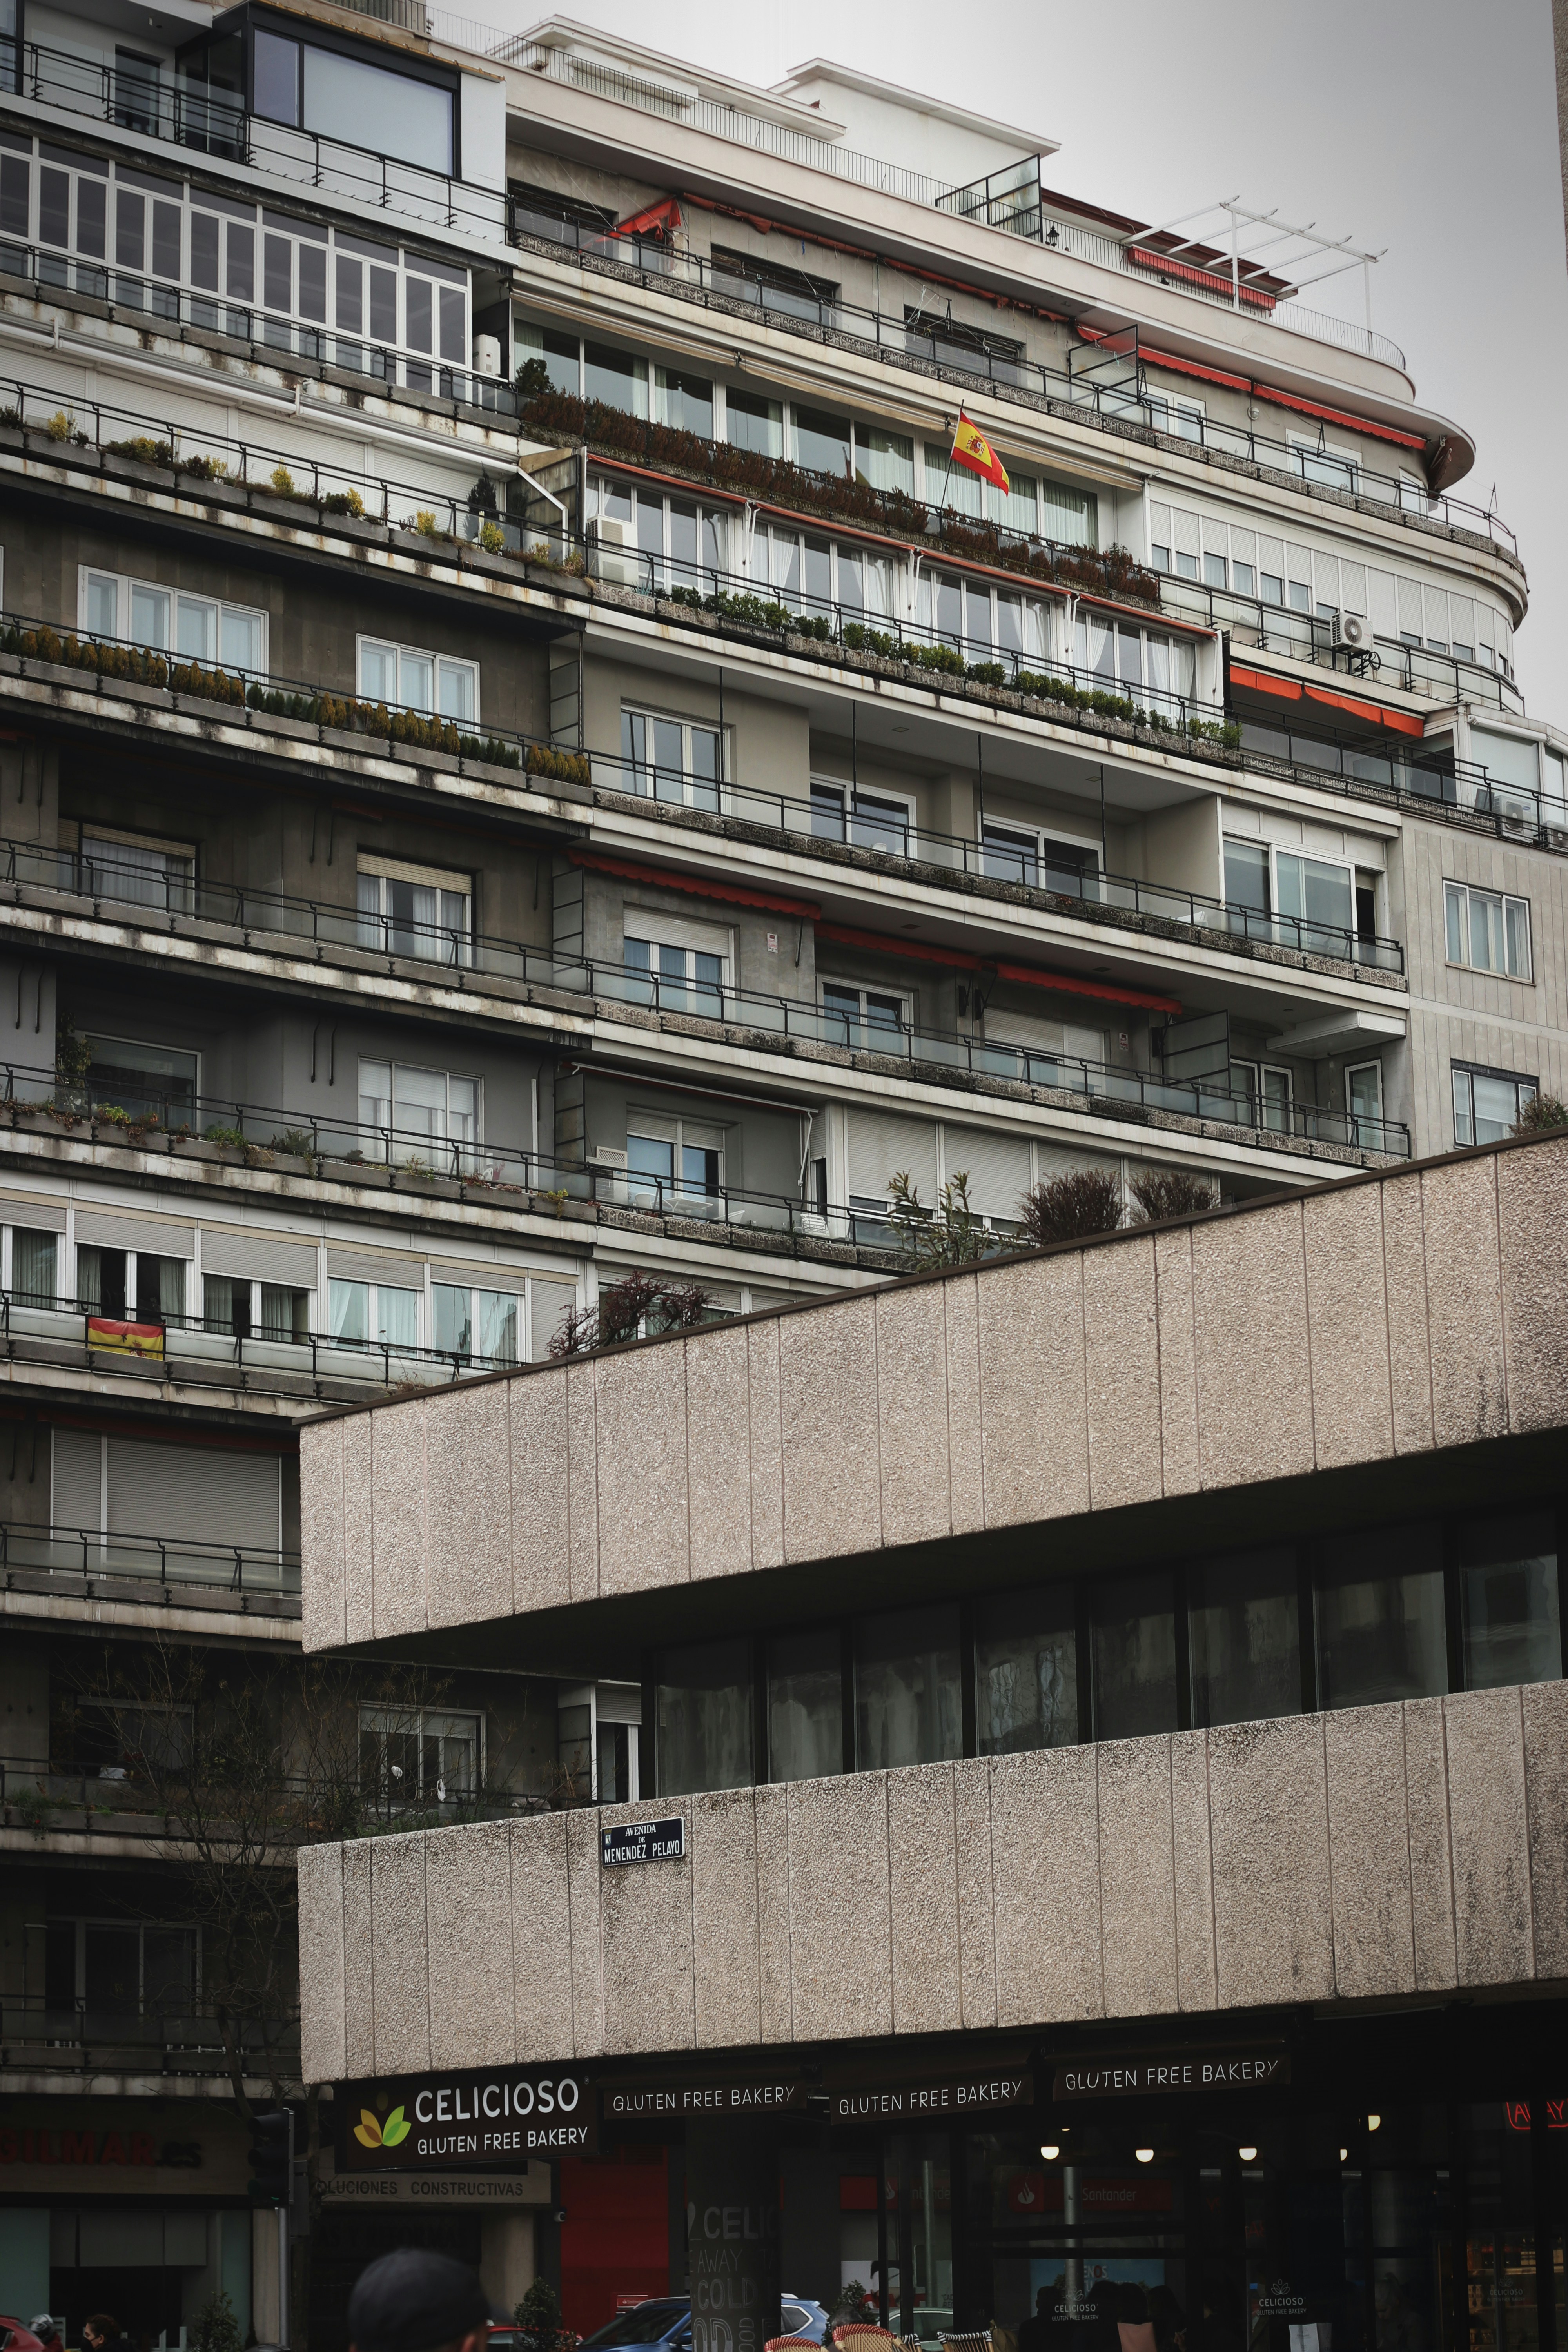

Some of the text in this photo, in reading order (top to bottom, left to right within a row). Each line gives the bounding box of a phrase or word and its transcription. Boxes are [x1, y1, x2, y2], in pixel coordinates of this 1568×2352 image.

[625, 1824, 656, 1837] AVENIDA
[604, 1840, 679, 1863] MENENDEZ PELAYO
[1066, 2060, 1278, 2090] GLUTEN FREE BAKERY
[416, 2078, 579, 2123] CELICIOSO
[613, 2086, 795, 2111] GLUTEN FREE BAKERY
[840, 2080, 1021, 2115] GLUTEN FREE BAKERY
[418, 2127, 588, 2154] GLUTEN FREE BAKERY
[411, 2181, 523, 2196] CONSTRUCTIVAS
[1082, 2188, 1136, 2201] Santander
[698, 2249, 742, 2273] AWAY
[698, 2278, 758, 2310] COLD
[1259, 2297, 1304, 2307] CELICIOSO
[1054, 2304, 1096, 2313] CELICIOSO
